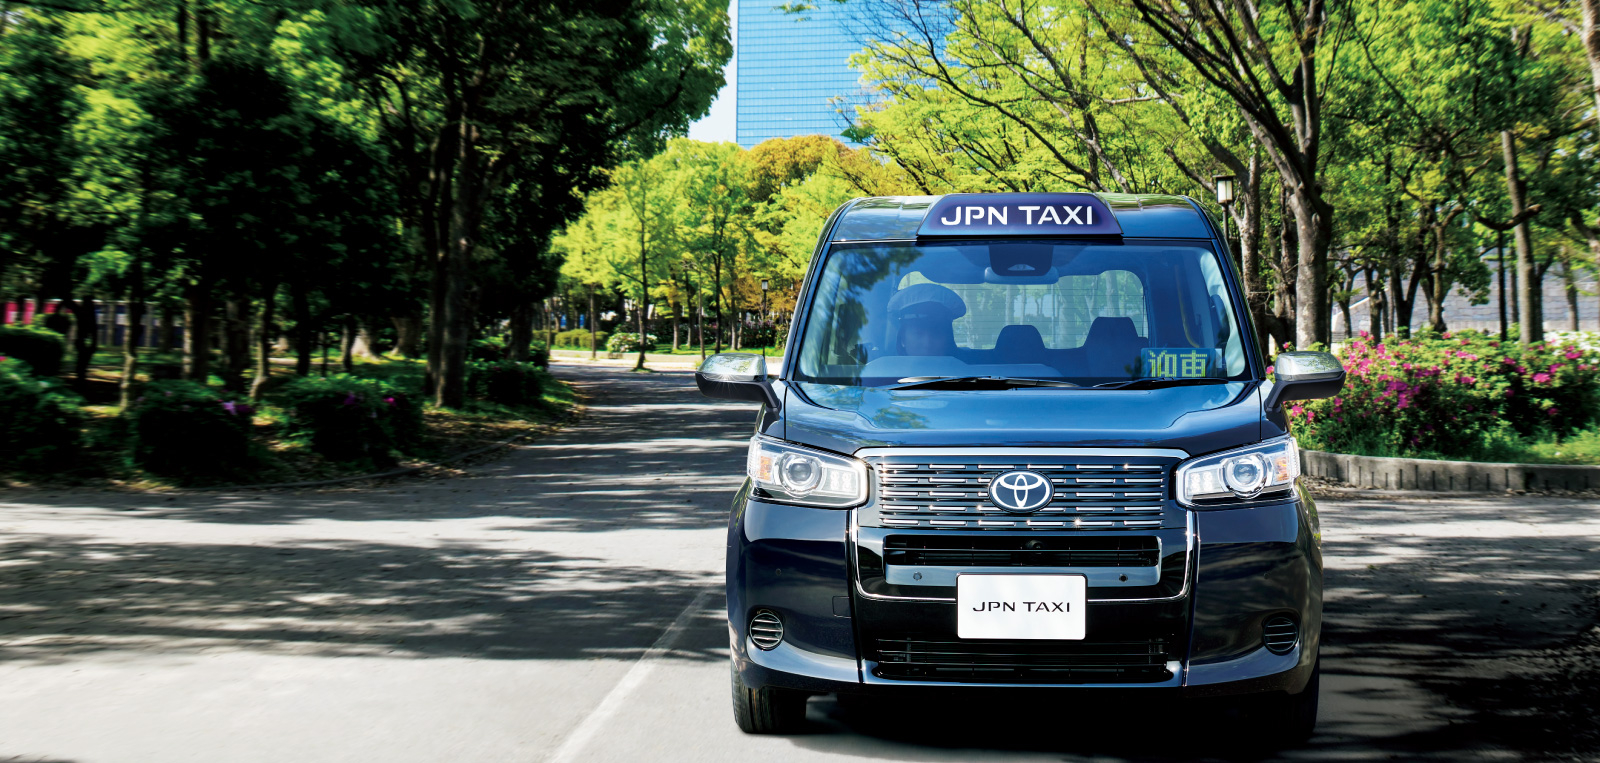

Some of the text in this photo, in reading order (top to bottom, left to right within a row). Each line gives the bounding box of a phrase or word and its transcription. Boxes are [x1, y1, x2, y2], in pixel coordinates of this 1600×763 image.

[941, 205, 1093, 225] JPN TAXI
[972, 601, 1070, 613] JPN TAXI
